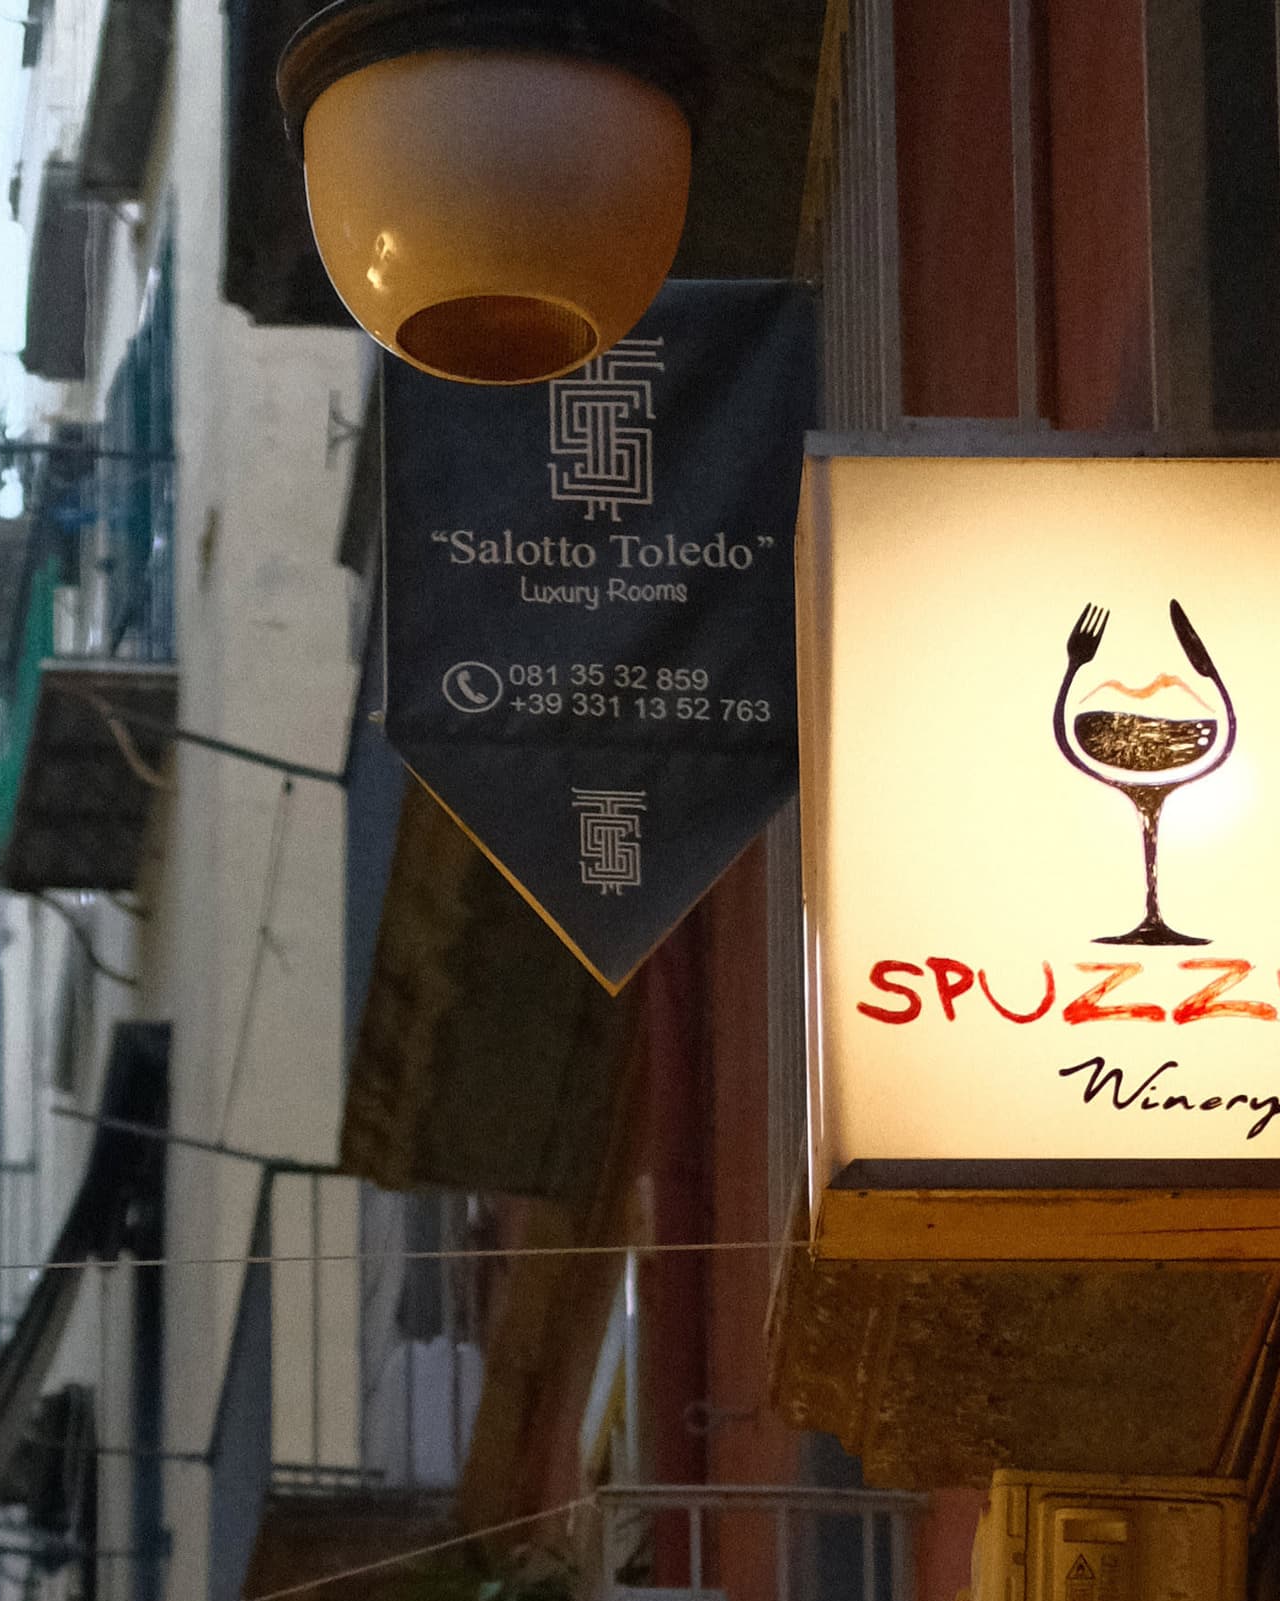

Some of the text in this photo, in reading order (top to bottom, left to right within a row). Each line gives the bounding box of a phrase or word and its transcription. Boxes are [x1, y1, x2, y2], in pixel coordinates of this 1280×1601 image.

[520, 577, 686, 610] Luxury Rooms
[509, 664, 709, 691] 081 35 32 859
[510, 692, 771, 723] +39 331 13 52 763
